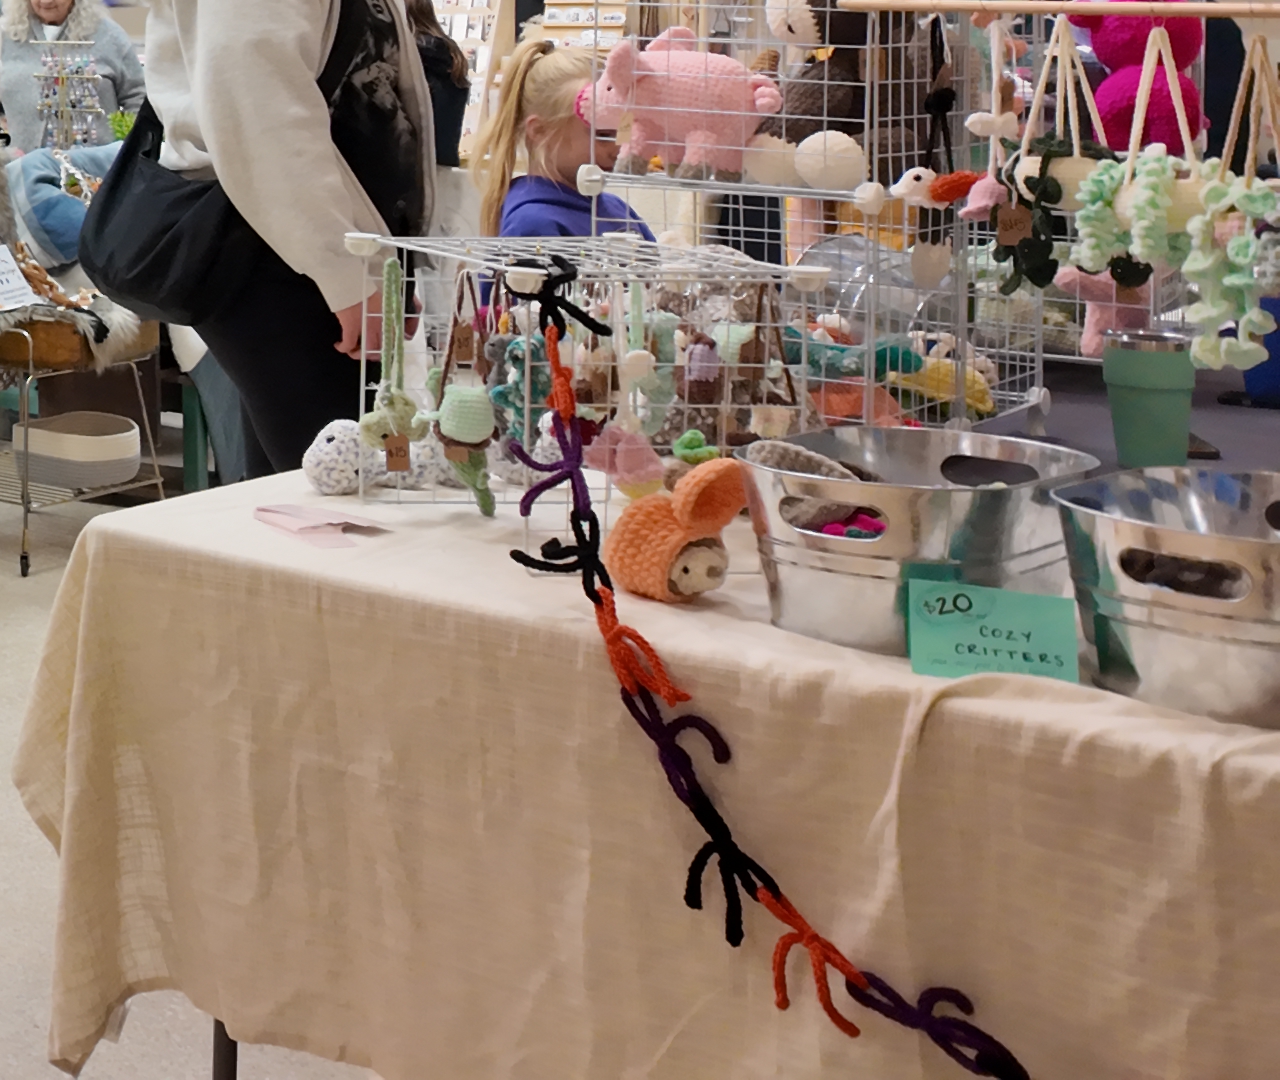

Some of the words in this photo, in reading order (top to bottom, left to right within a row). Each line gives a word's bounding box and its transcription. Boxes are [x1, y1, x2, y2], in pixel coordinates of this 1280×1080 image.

[922, 592, 973, 616] $20
[978, 624, 1032, 644] COZY
[954, 642, 1065, 668] CRITTERS
